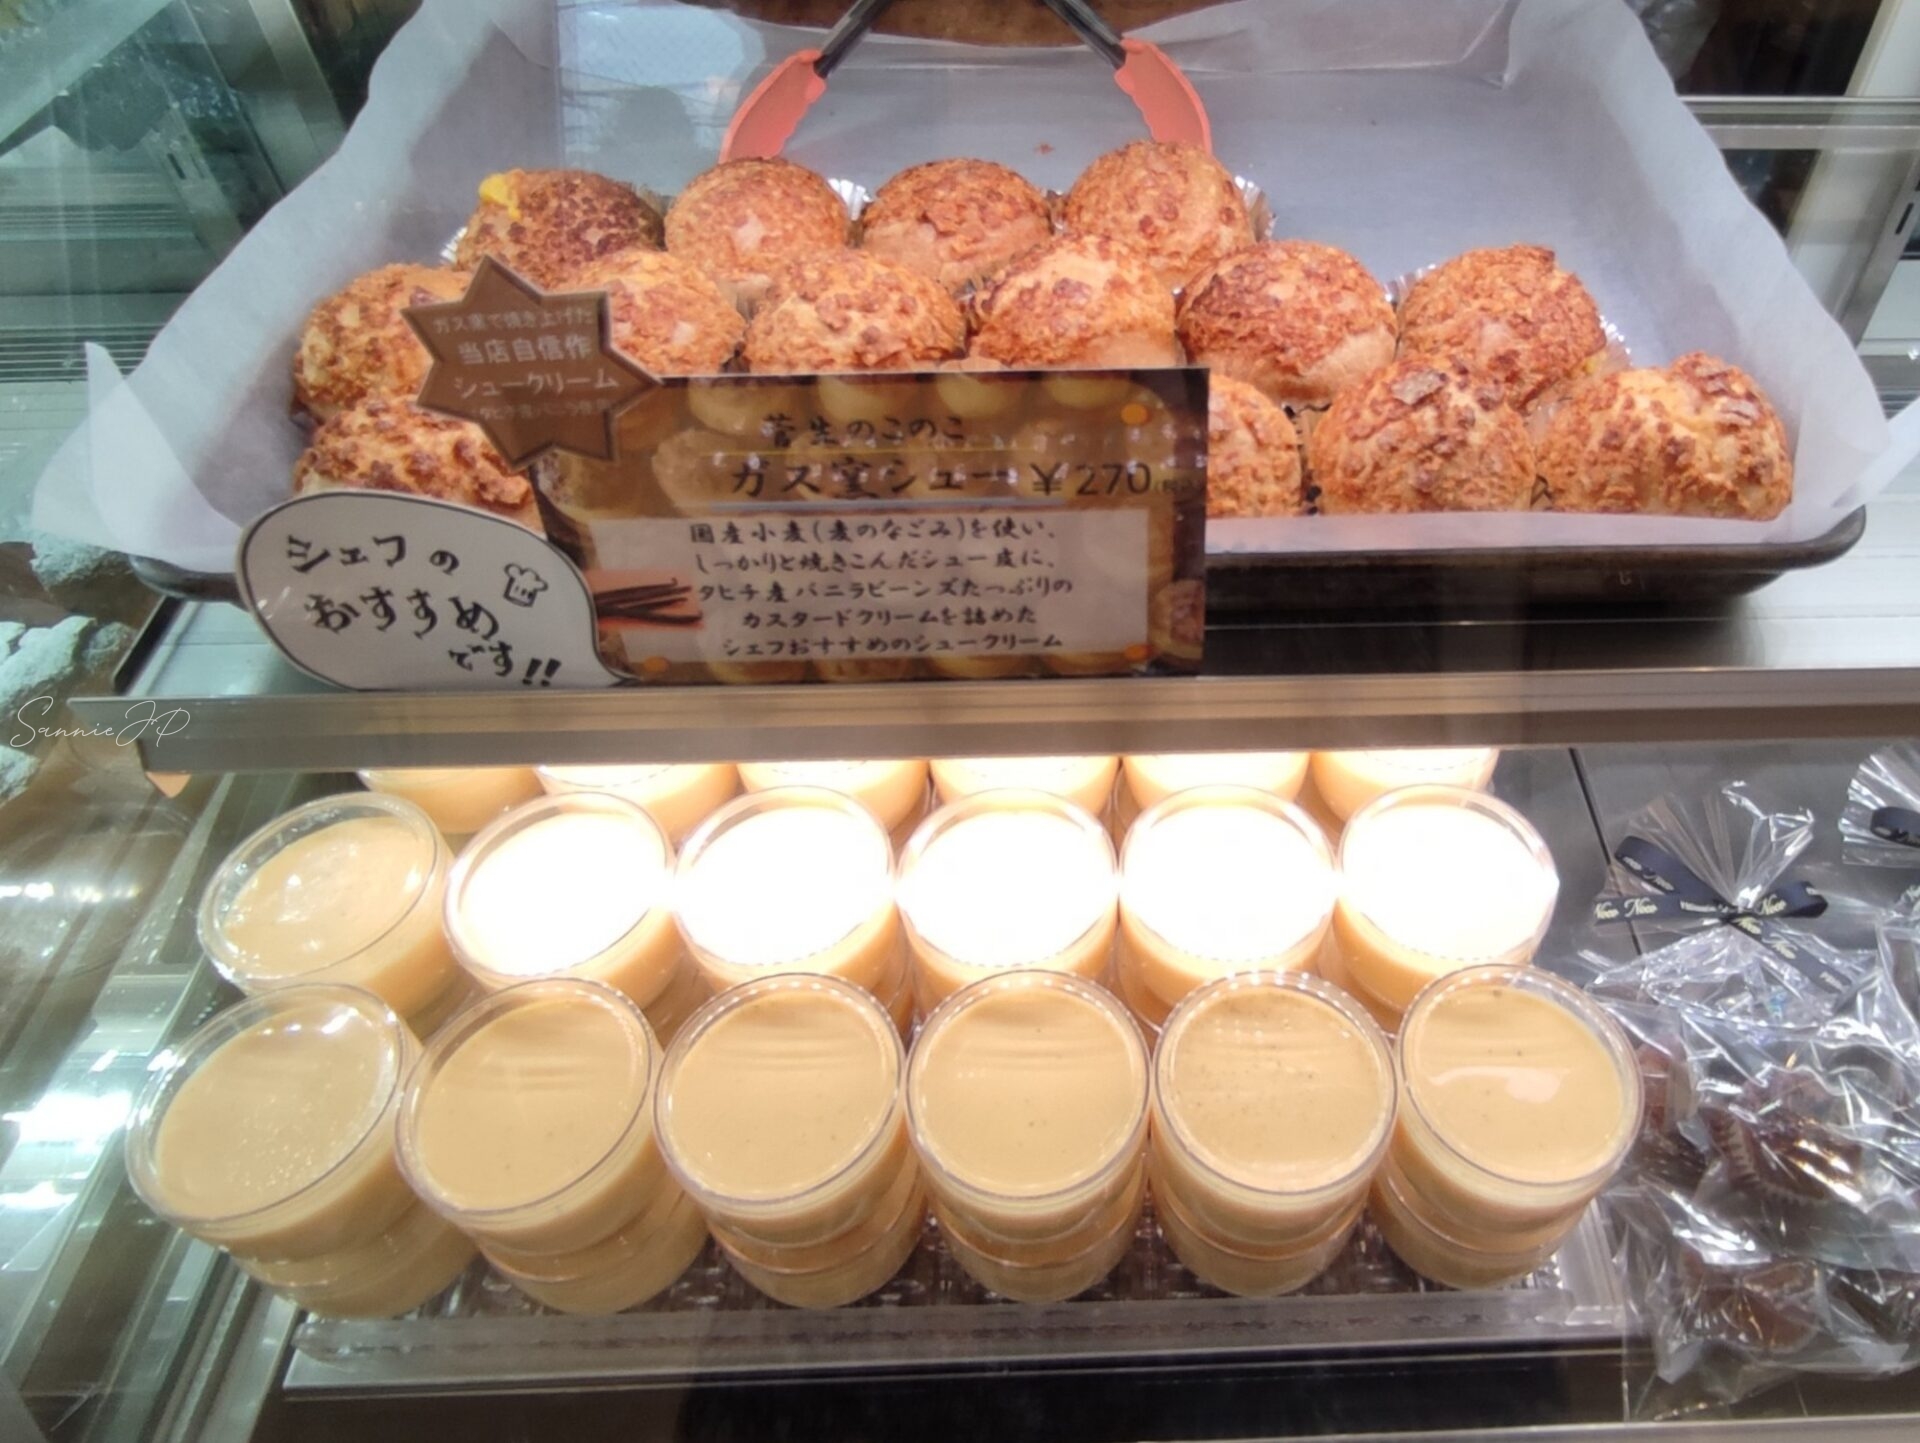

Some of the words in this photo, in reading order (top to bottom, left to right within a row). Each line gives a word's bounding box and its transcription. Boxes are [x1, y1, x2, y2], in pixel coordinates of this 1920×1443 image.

[458, 332, 592, 365] 当店自信作
[454, 367, 621, 399] シュークリーム
[286, 534, 462, 576] シェフの
[304, 586, 500, 640] おすすめ
